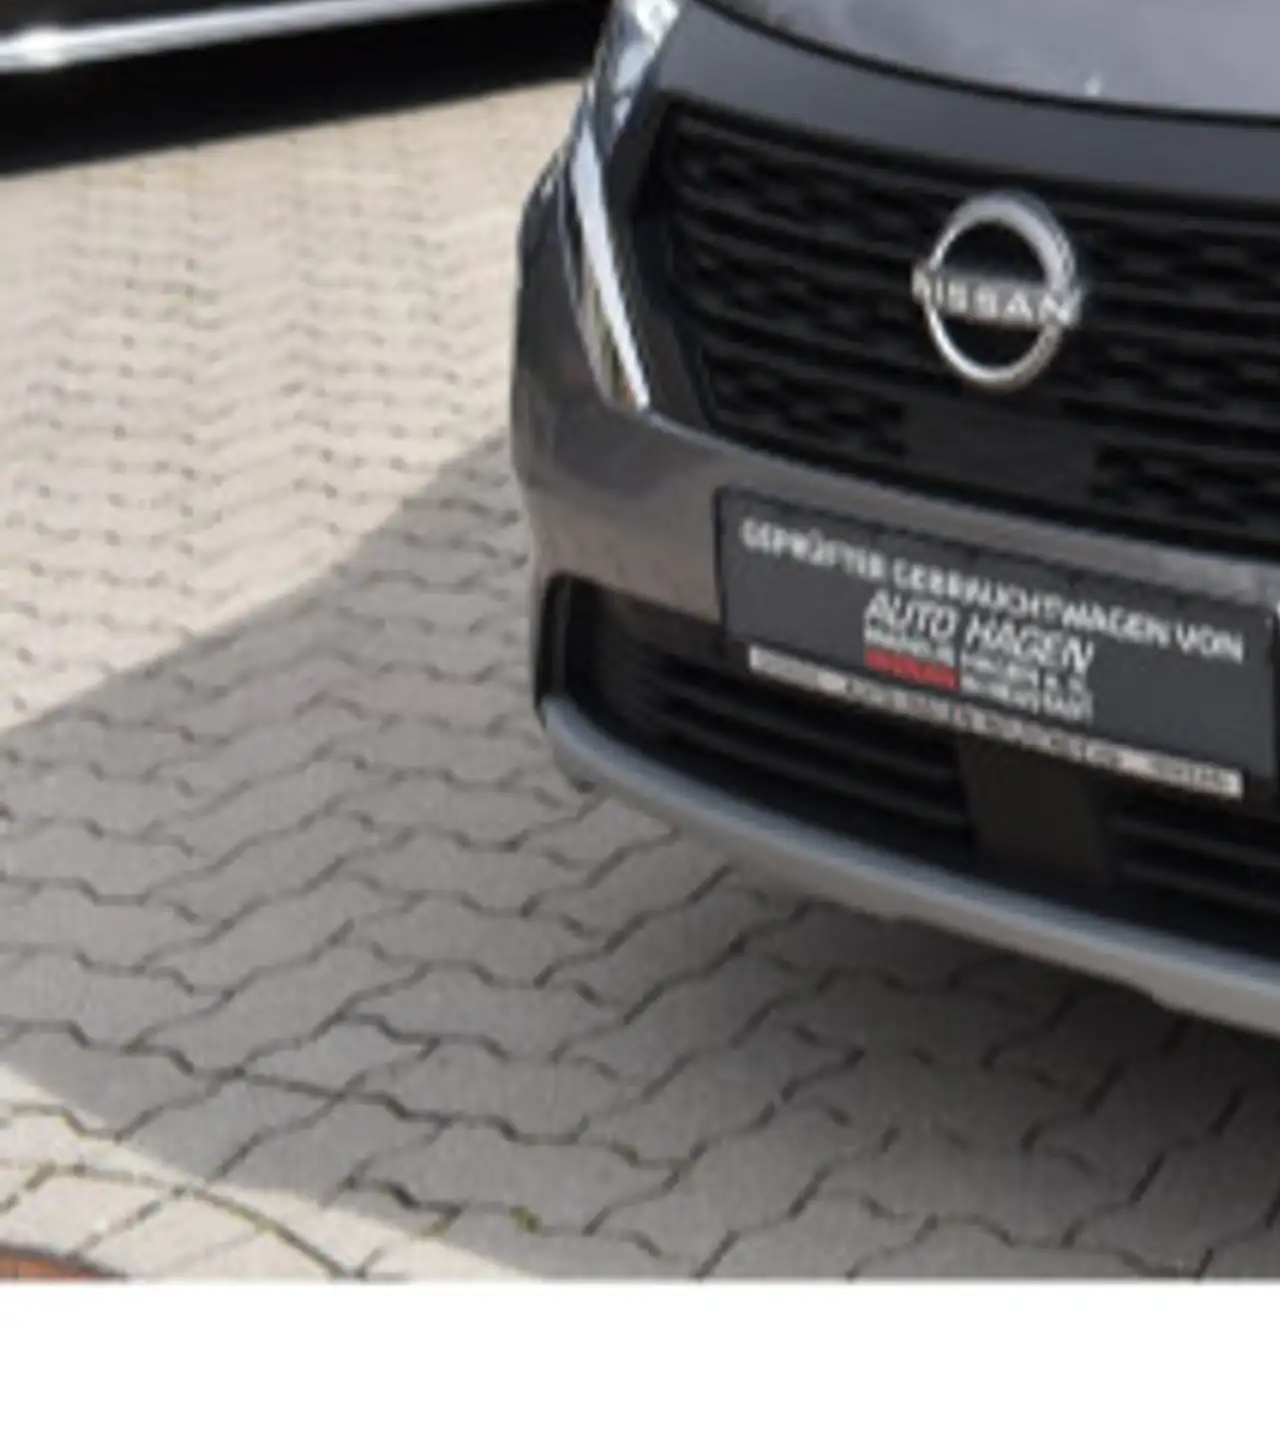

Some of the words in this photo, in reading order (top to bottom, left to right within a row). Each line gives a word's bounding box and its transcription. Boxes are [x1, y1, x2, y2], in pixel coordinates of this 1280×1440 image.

[911, 266, 1083, 330] NISSAN
[864, 587, 959, 644] AUTO
[964, 612, 1096, 676] HAGEN
[1174, 621, 1244, 664] VON
